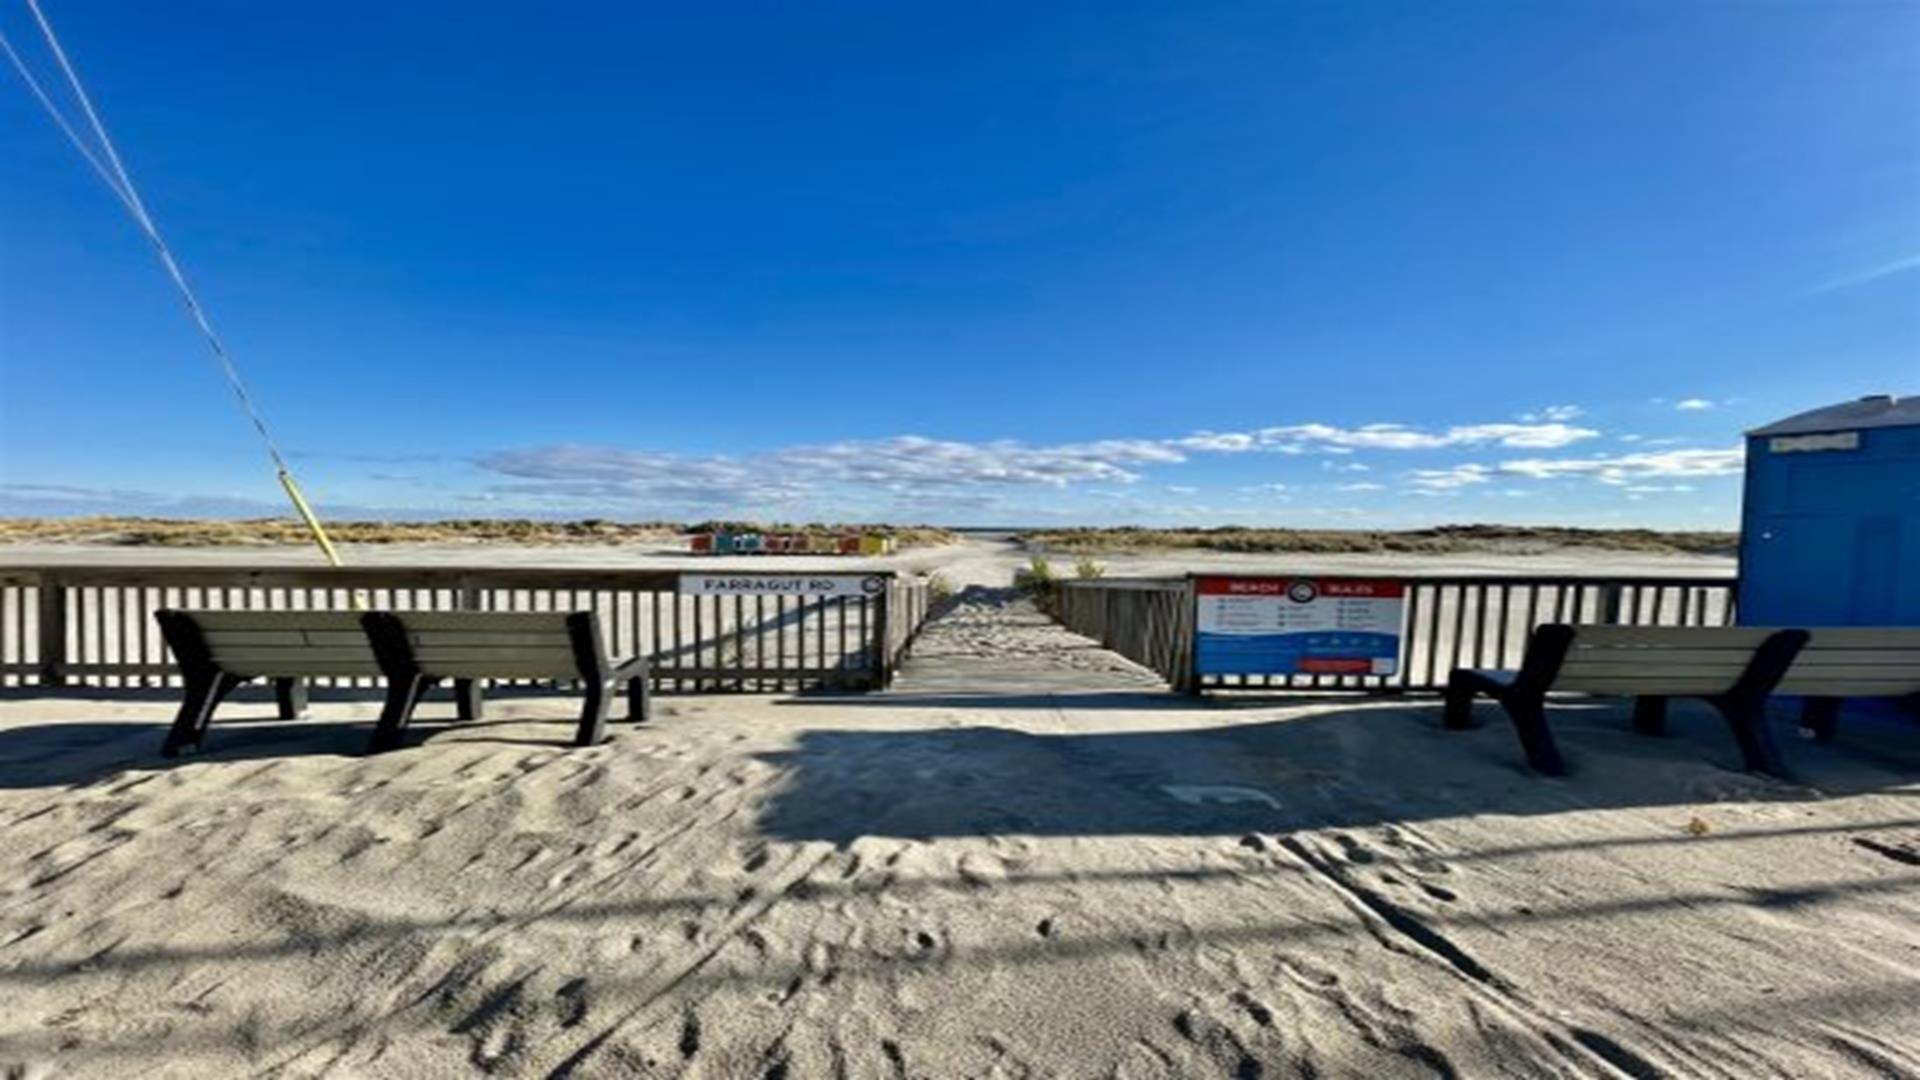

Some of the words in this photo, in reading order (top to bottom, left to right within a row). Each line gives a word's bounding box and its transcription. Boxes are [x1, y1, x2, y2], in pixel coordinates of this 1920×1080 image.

[704, 578, 801, 591] FARRAGUT
[809, 579, 836, 590] RD
[1230, 583, 1280, 593] BEACH
[1329, 584, 1374, 595] RULES
